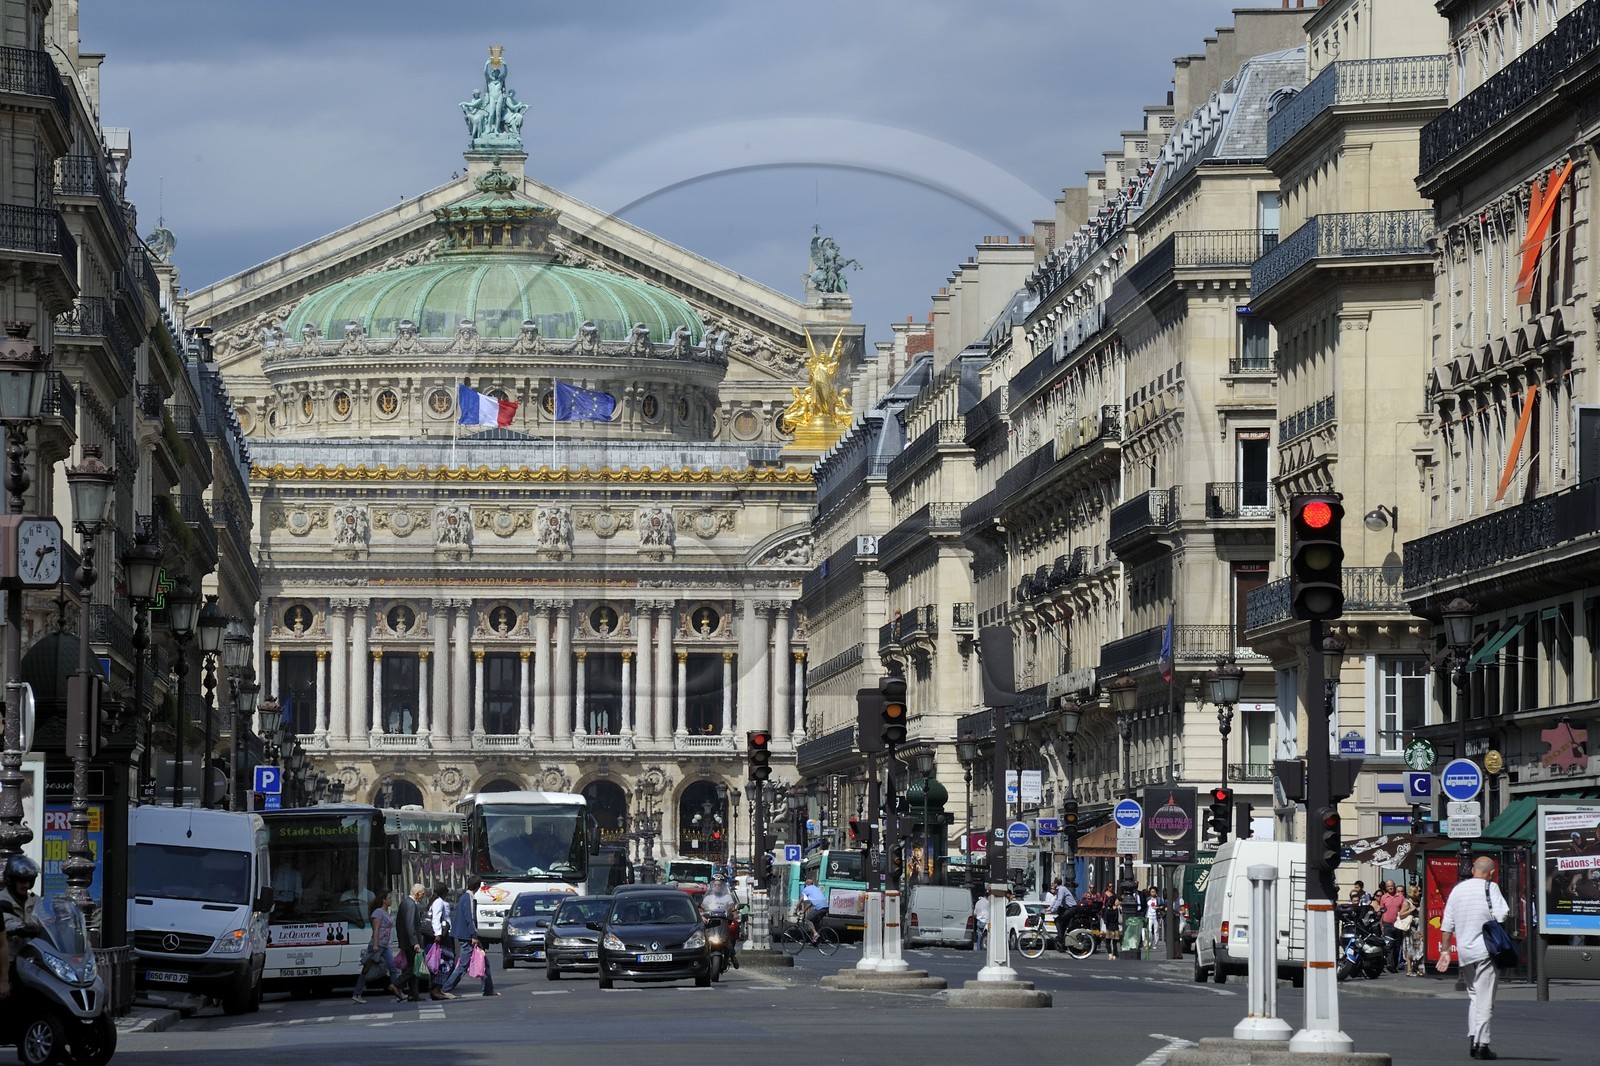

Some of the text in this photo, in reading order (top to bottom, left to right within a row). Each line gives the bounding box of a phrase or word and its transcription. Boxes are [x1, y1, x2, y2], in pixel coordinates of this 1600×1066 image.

[394, 577, 611, 586] ACADEMIE NATIONALE DE MUSIQUE
[262, 771, 275, 788] P
[1414, 778, 1427, 793] C
[280, 827, 310, 837] Stade
[789, 849, 797, 859] P
